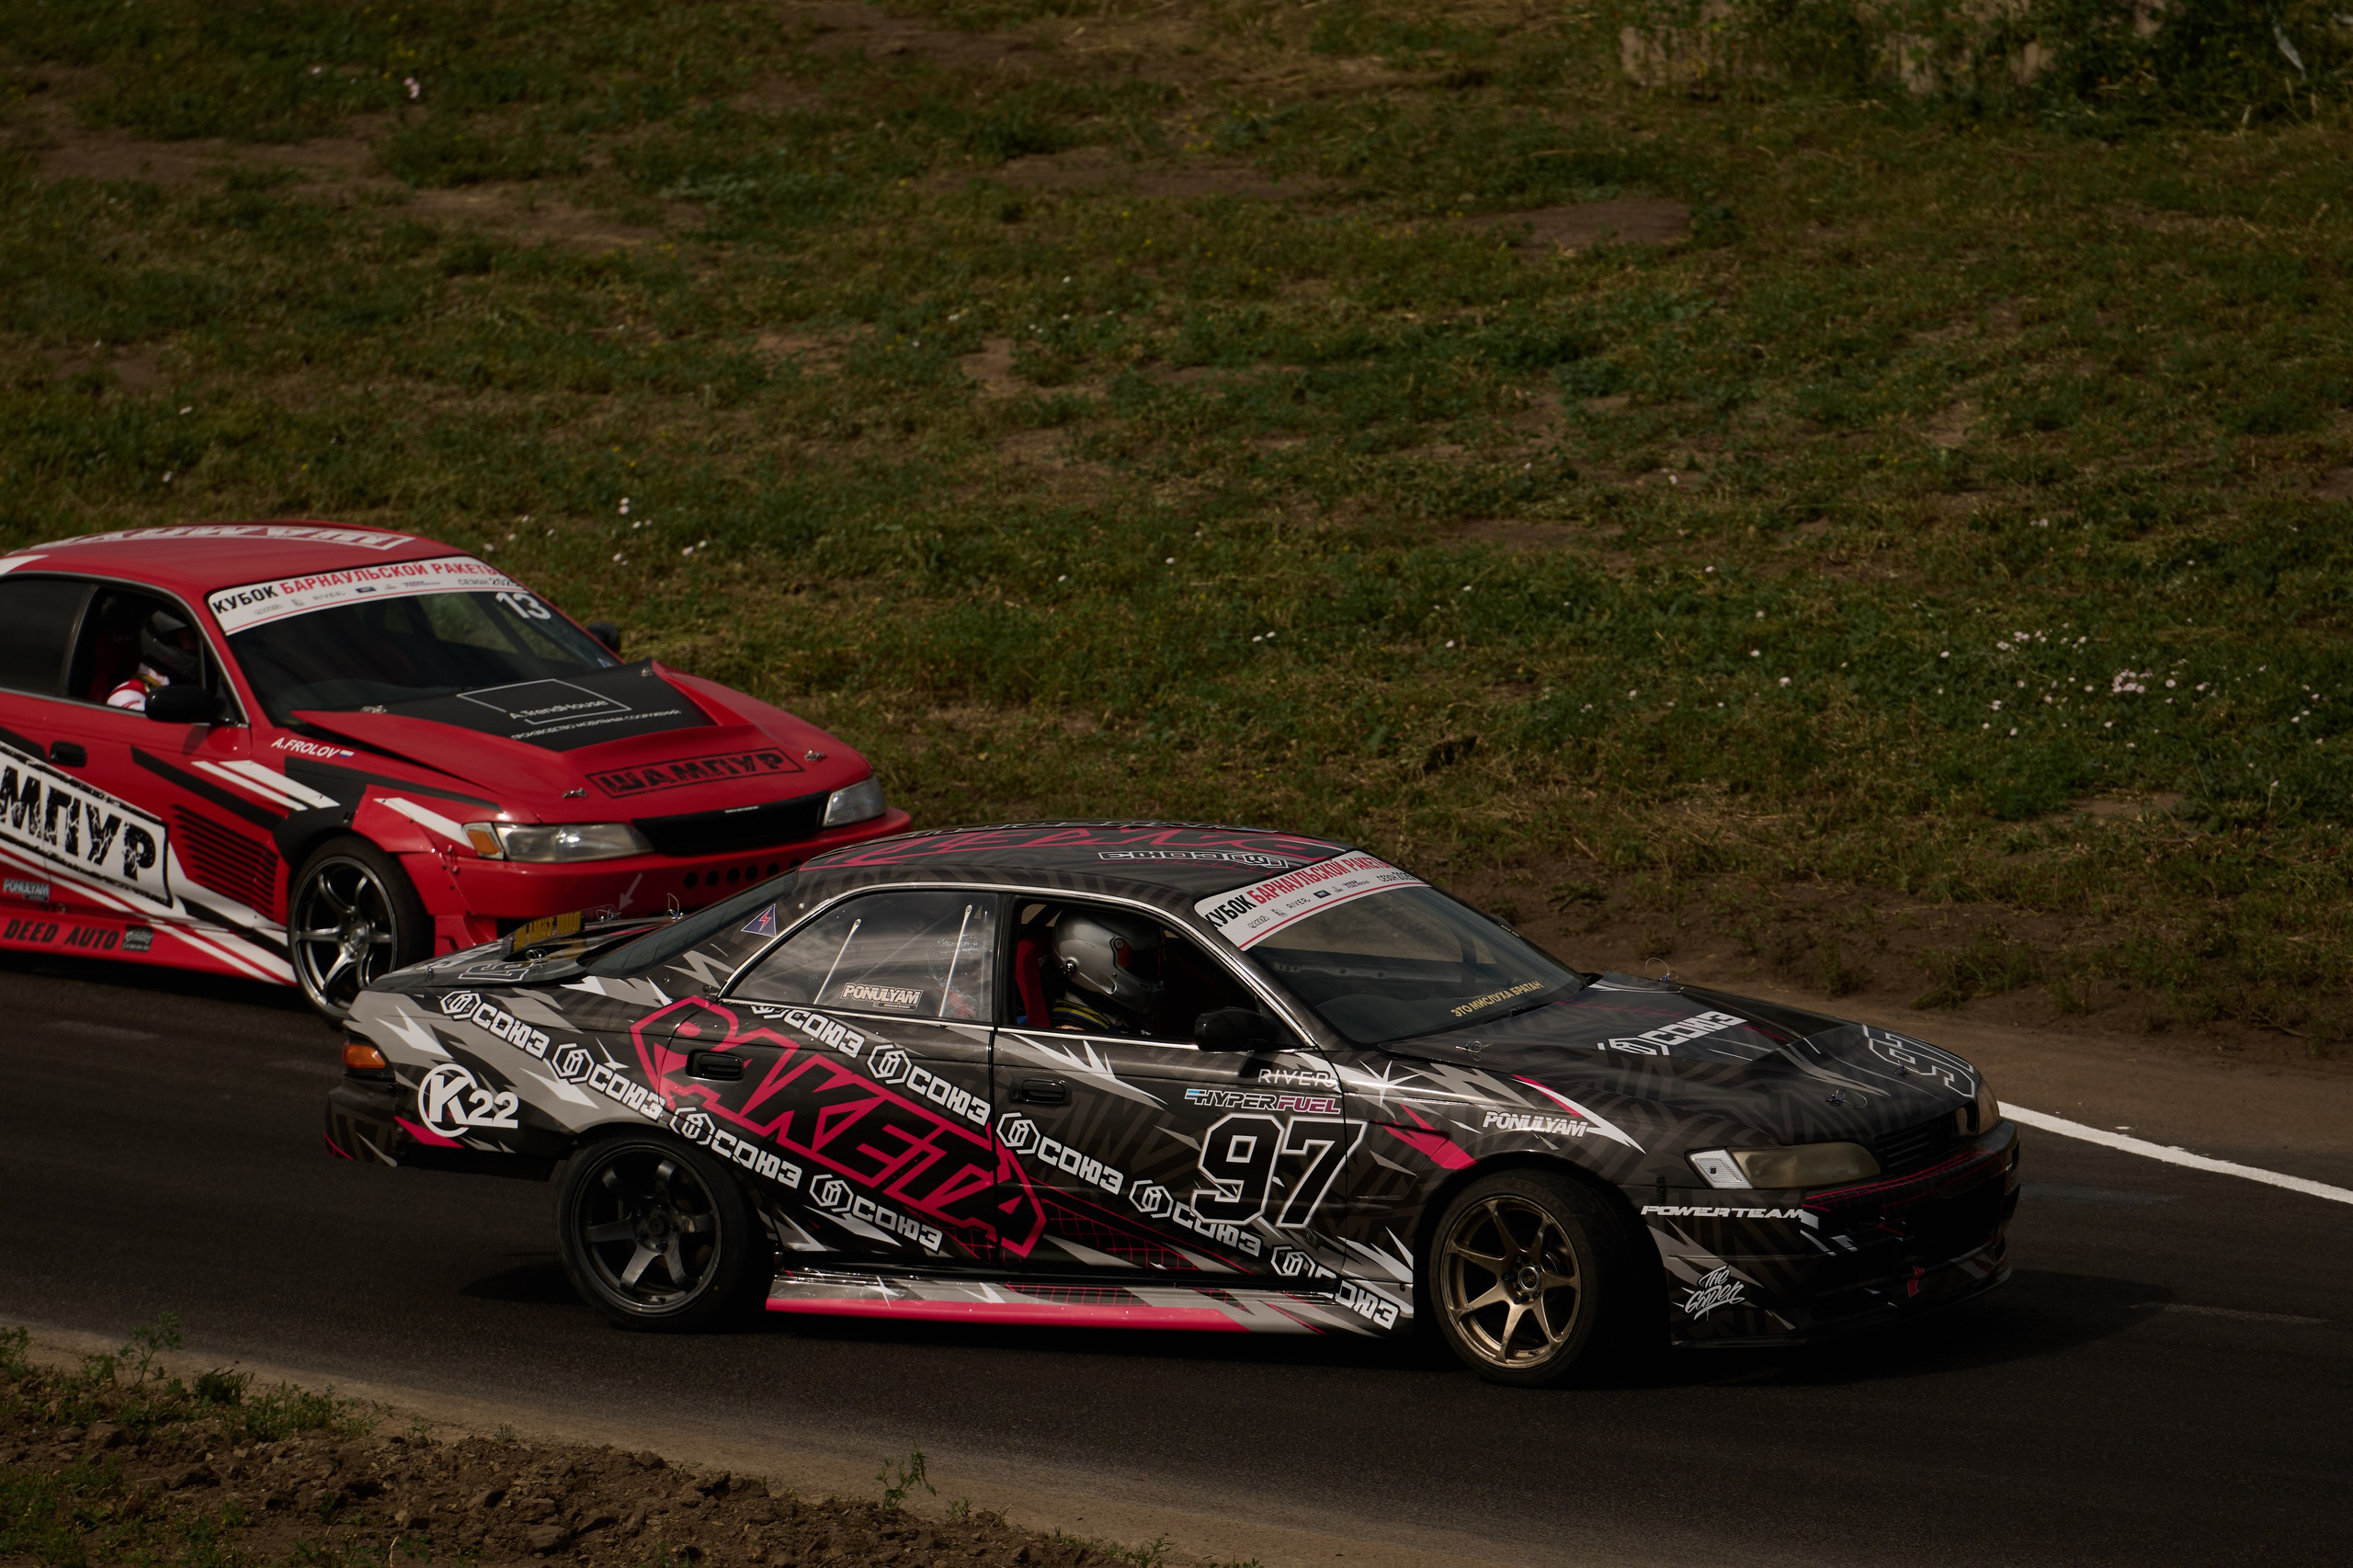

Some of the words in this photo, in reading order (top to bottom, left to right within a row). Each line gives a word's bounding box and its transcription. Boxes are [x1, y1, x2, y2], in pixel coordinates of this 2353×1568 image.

[212, 585, 278, 614] КУБОК
[280, 562, 428, 595] БАРНАУЛЬСКОЙ
[494, 591, 551, 620] 13
[271, 737, 340, 758] A.FROLOV
[599, 752, 783, 792] ШАМПУР
[1204, 894, 1256, 930] КУБОК
[1246, 858, 1351, 904] БАРНАУЛЬСКОЙ
[843, 983, 921, 1005] PONULYAM
[1450, 1005, 1472, 1017] ЭТО
[1468, 990, 1515, 1010] МИСЛУХА
[1509, 981, 1544, 995] БРАТАН
[472, 1004, 551, 1060] СОЮЗ
[784, 1007, 865, 1058] СОЮЗ
[1637, 1011, 1747, 1045] СОЮЗ
[587, 1064, 667, 1119] СОЮЗ
[905, 1063, 992, 1128] СОЮЗ
[1257, 1068, 1337, 1088] RIVER
[1483, 1111, 1588, 1138] PONULYAM
[710, 1128, 803, 1189] СОЮЗ
[1036, 1136, 1126, 1196] СОЮЗ
[1190, 1111, 1368, 1230] 97
[851, 1194, 945, 1253] СОЮЗ
